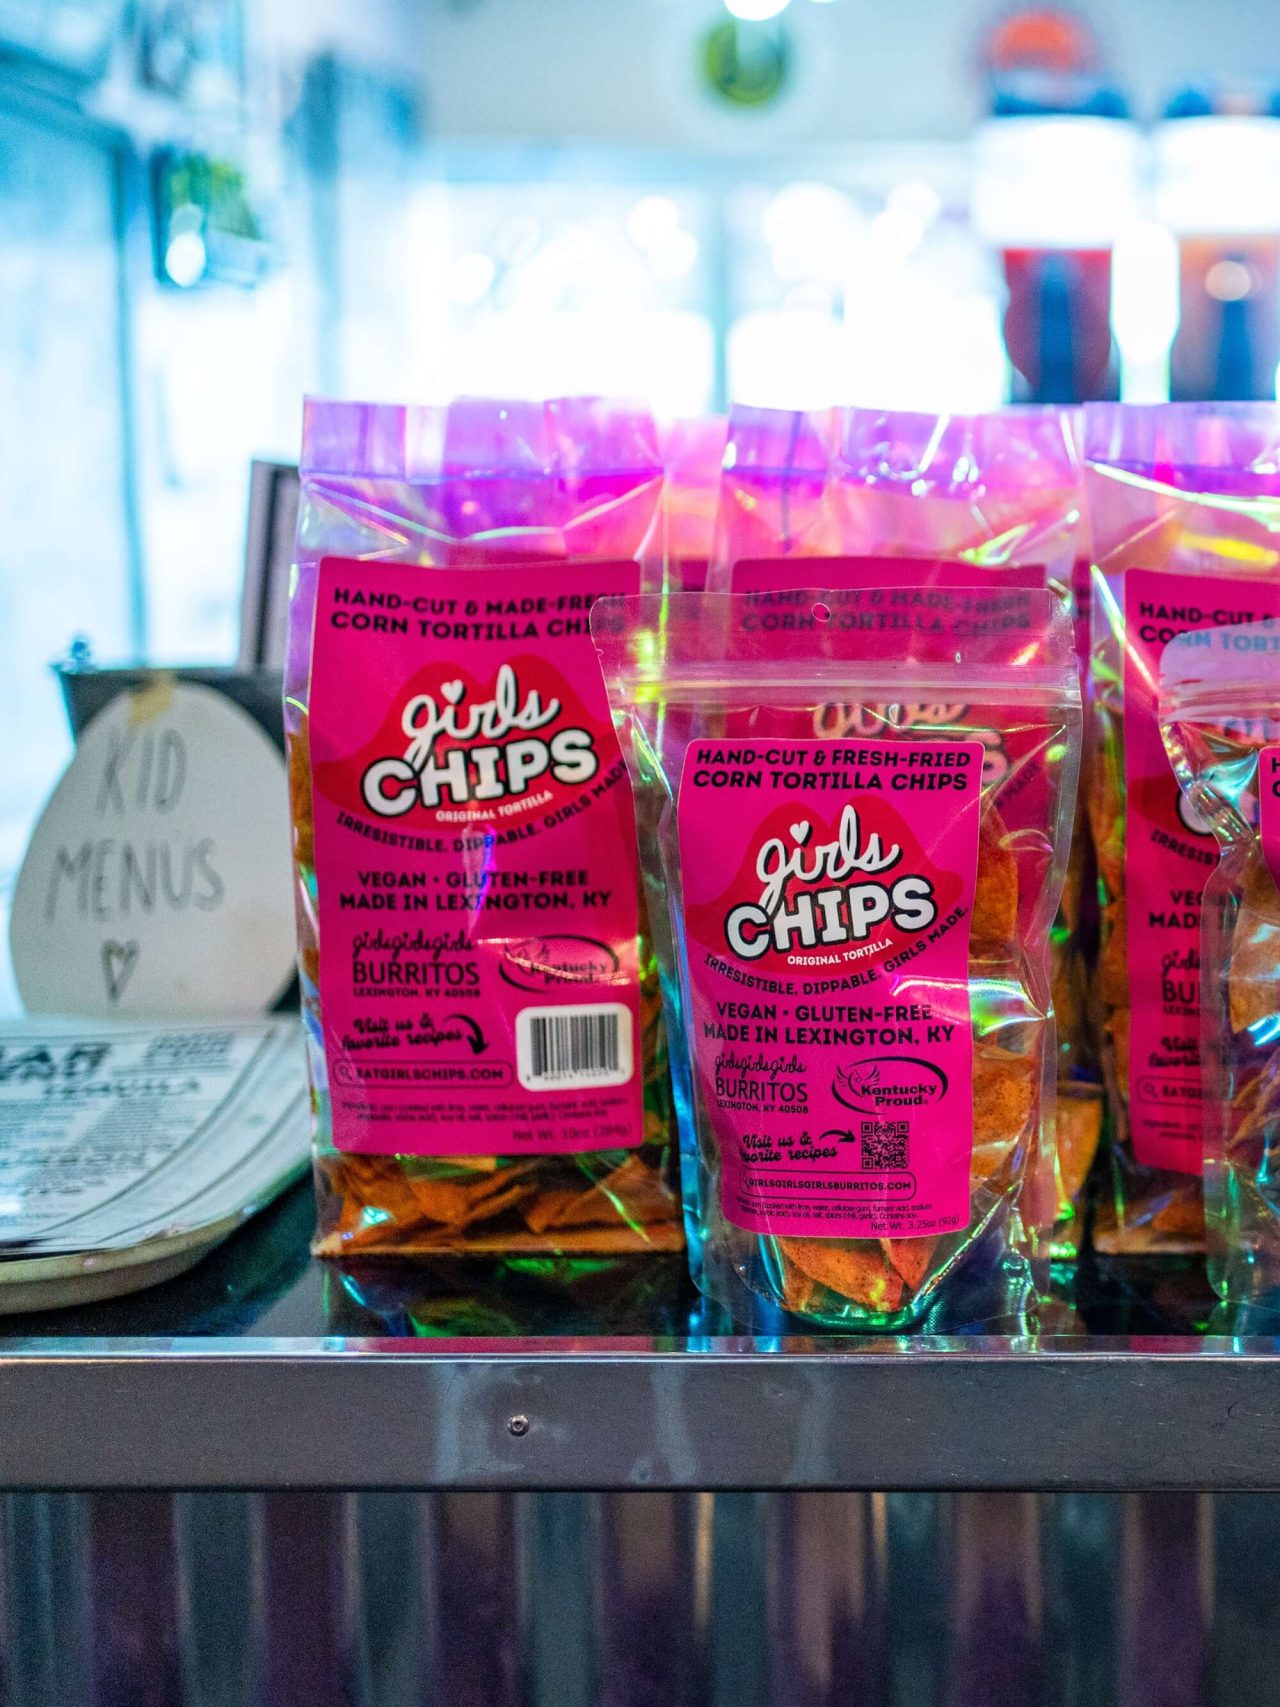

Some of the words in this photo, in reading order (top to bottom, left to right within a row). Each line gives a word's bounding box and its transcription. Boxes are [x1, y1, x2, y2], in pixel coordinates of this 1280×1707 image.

[334, 587, 456, 615] HAND-CUT
[465, 599, 478, 615] &
[330, 611, 408, 635] CORN
[418, 620, 539, 641] TORTILLA
[1140, 603, 1257, 626] HAND-CUT
[402, 663, 560, 770] girls
[98, 727, 187, 813] KID
[696, 749, 808, 766] HAND-CUT
[813, 750, 826, 766] &
[831, 750, 971, 767] FRESH-FRIED
[361, 728, 598, 817] CHIPS
[693, 770, 762, 789] CORN
[770, 771, 883, 790] TORTILLA
[891, 773, 968, 791] CHIPS
[436, 809, 495, 822] ORIGINAL
[498, 790, 554, 816] TORTILLA
[544, 794, 592, 829] GIRLS
[756, 804, 902, 914] girls
[46, 836, 225, 928] MENUS
[357, 872, 426, 888] VEGAN
[445, 870, 589, 888] GLUTEN-FREE
[340, 894, 397, 911] MADE
[403, 894, 428, 911] IN
[581, 891, 612, 908] KY
[725, 874, 938, 961] CHIPS
[704, 952, 798, 995] IRRESISTIBLE.
[802, 970, 881, 995] DIPPABLE.
[883, 940, 928, 973] GIRLS
[927, 907, 969, 945] MADE.
[787, 954, 841, 966] ORIGINAL
[842, 937, 893, 961] TORTILLA
[353, 962, 480, 985] BURRITOS
[716, 1002, 777, 1021] VEGAN
[795, 1003, 933, 1023] GLUTEN-FREE
[406, 1029, 463, 1047] recipes
[704, 1023, 749, 1043] MADE
[755, 1026, 779, 1043] IN
[785, 1026, 920, 1047] LEXINGTON,
[927, 1025, 956, 1042] KY
[715, 1077, 808, 1103] BURRITOS
[861, 1084, 937, 1096] Kentucky
[779, 1105, 809, 1114] 40508
[743, 1134, 772, 1149] Visit
[778, 1136, 794, 1147] us
[788, 1146, 838, 1162] recipes
[871, 1221, 887, 1230] Net
